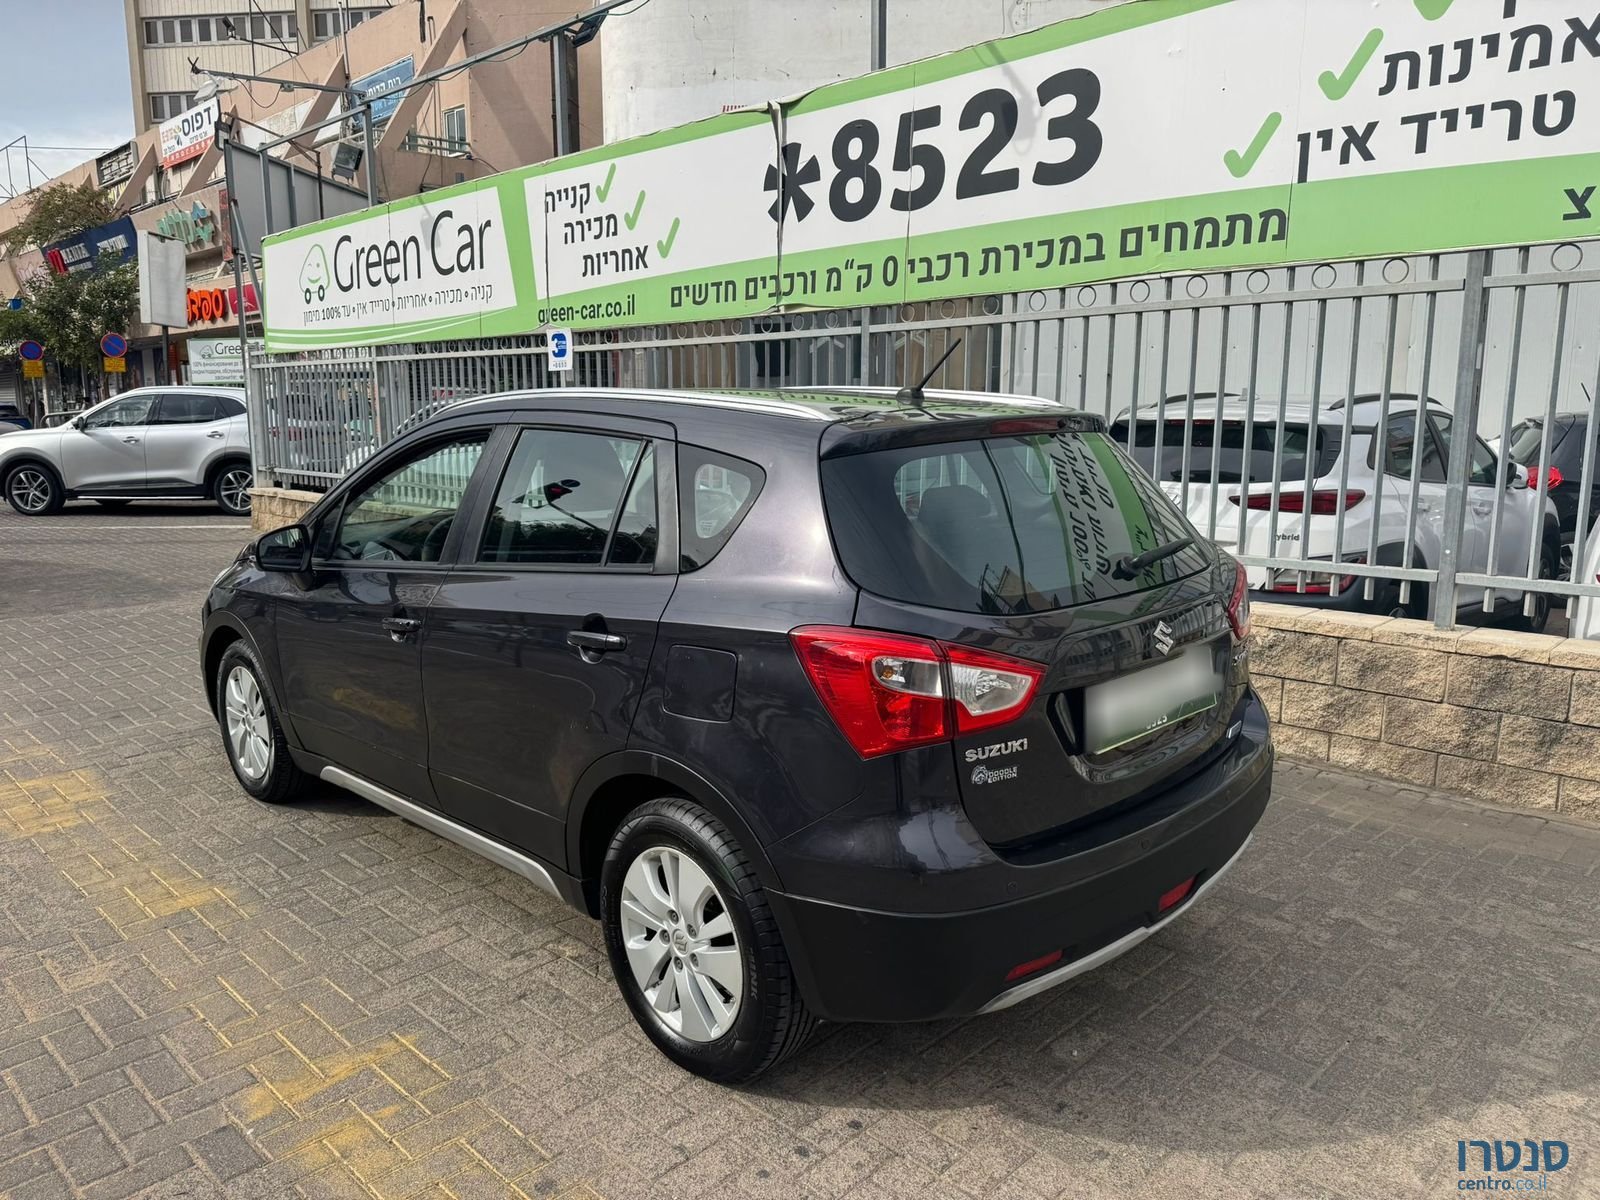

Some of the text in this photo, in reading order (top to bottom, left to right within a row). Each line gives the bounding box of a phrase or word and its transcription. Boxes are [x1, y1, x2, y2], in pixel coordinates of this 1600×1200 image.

[1378, 12, 1600, 96] אמינות
[181, 106, 212, 137] דפוס
[1297, 90, 1577, 184] טרייד אין
[545, 182, 591, 214] קנייה
[564, 213, 618, 245] מכירה
[1119, 208, 1288, 259] מתמחים
[334, 209, 492, 293] Green Car
[582, 245, 649, 277] אחריות
[907, 251, 970, 283] רכבי
[979, 232, 1106, 276] במכירת
[744, 270, 817, 301] ורכבים
[882, 255, 899, 287] 0
[303, 284, 493, 326] קניה מכירה אחריות טרייד אין עד 100% מימון
[670, 280, 737, 308] חדשים
[214, 342, 243, 354] Gree
[965, 737, 1028, 763] SUZUKI
